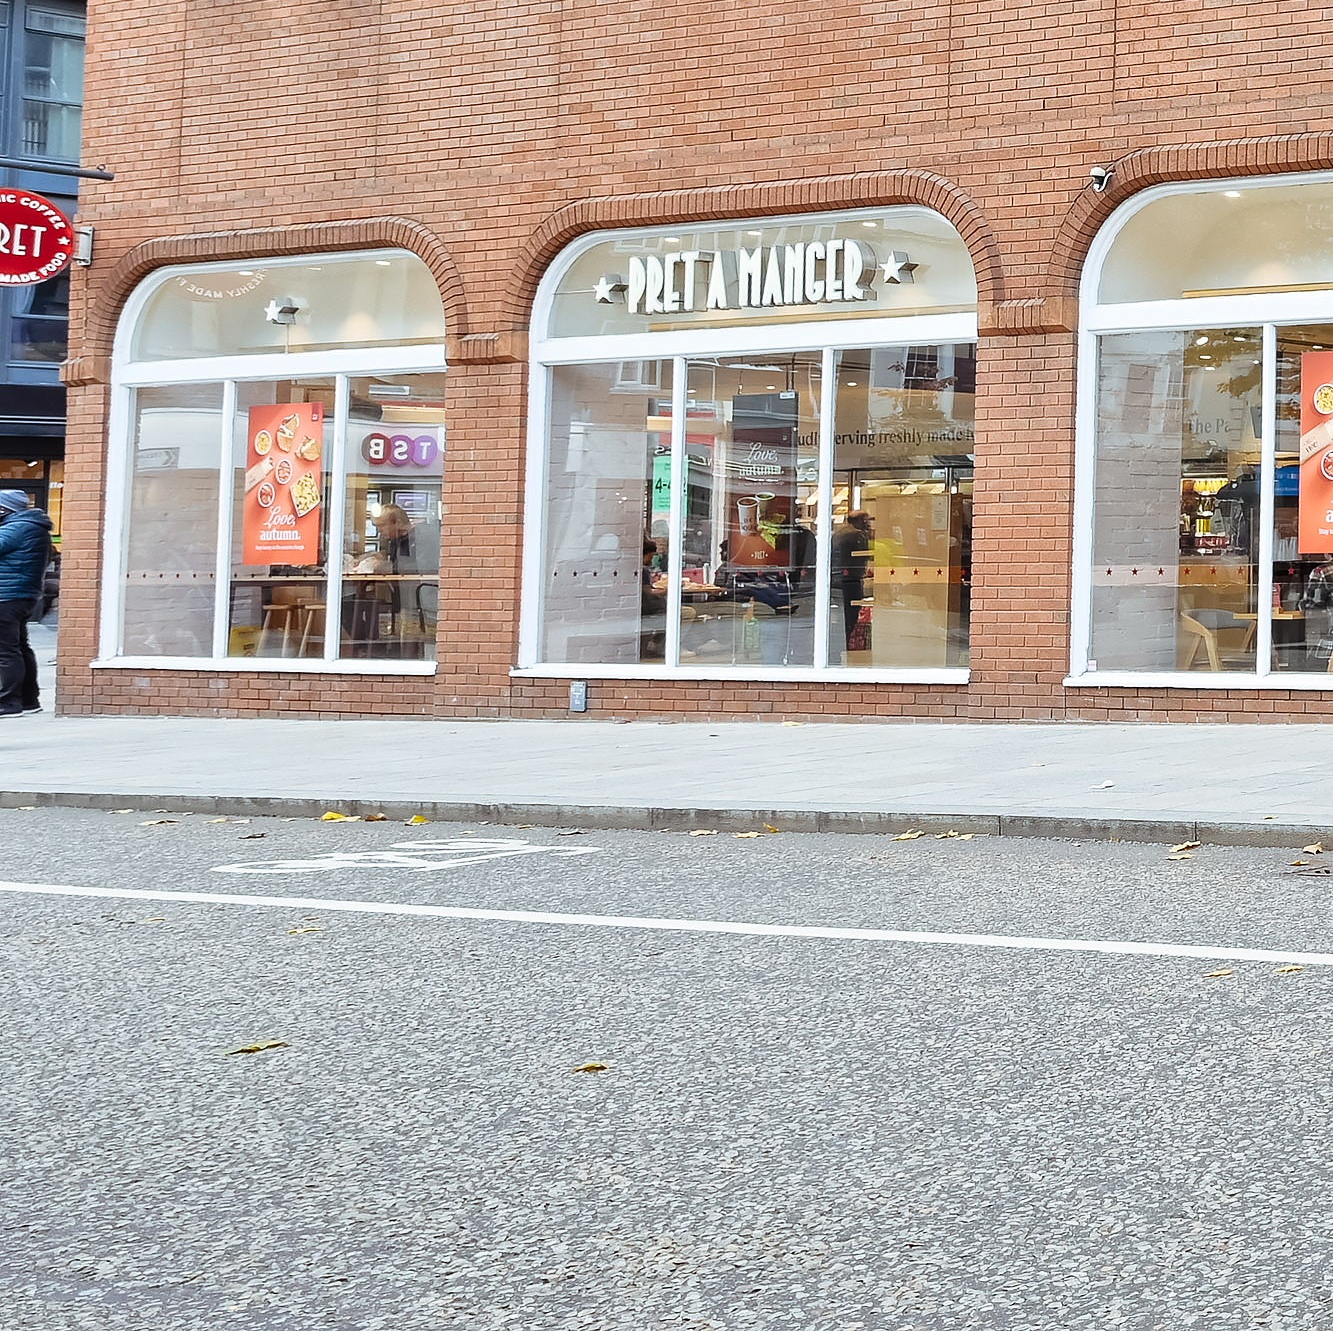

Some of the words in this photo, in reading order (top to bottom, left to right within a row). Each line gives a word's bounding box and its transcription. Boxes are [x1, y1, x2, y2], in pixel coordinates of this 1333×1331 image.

[19, 196, 66, 230] COFFEE
[0, 221, 48, 258] RET
[0, 271, 40, 283] MADE
[38, 252, 67, 276] FOOD
[628, 249, 712, 315] PRET
[738, 238, 877, 308] MANGER
[743, 442, 779, 465] Love,
